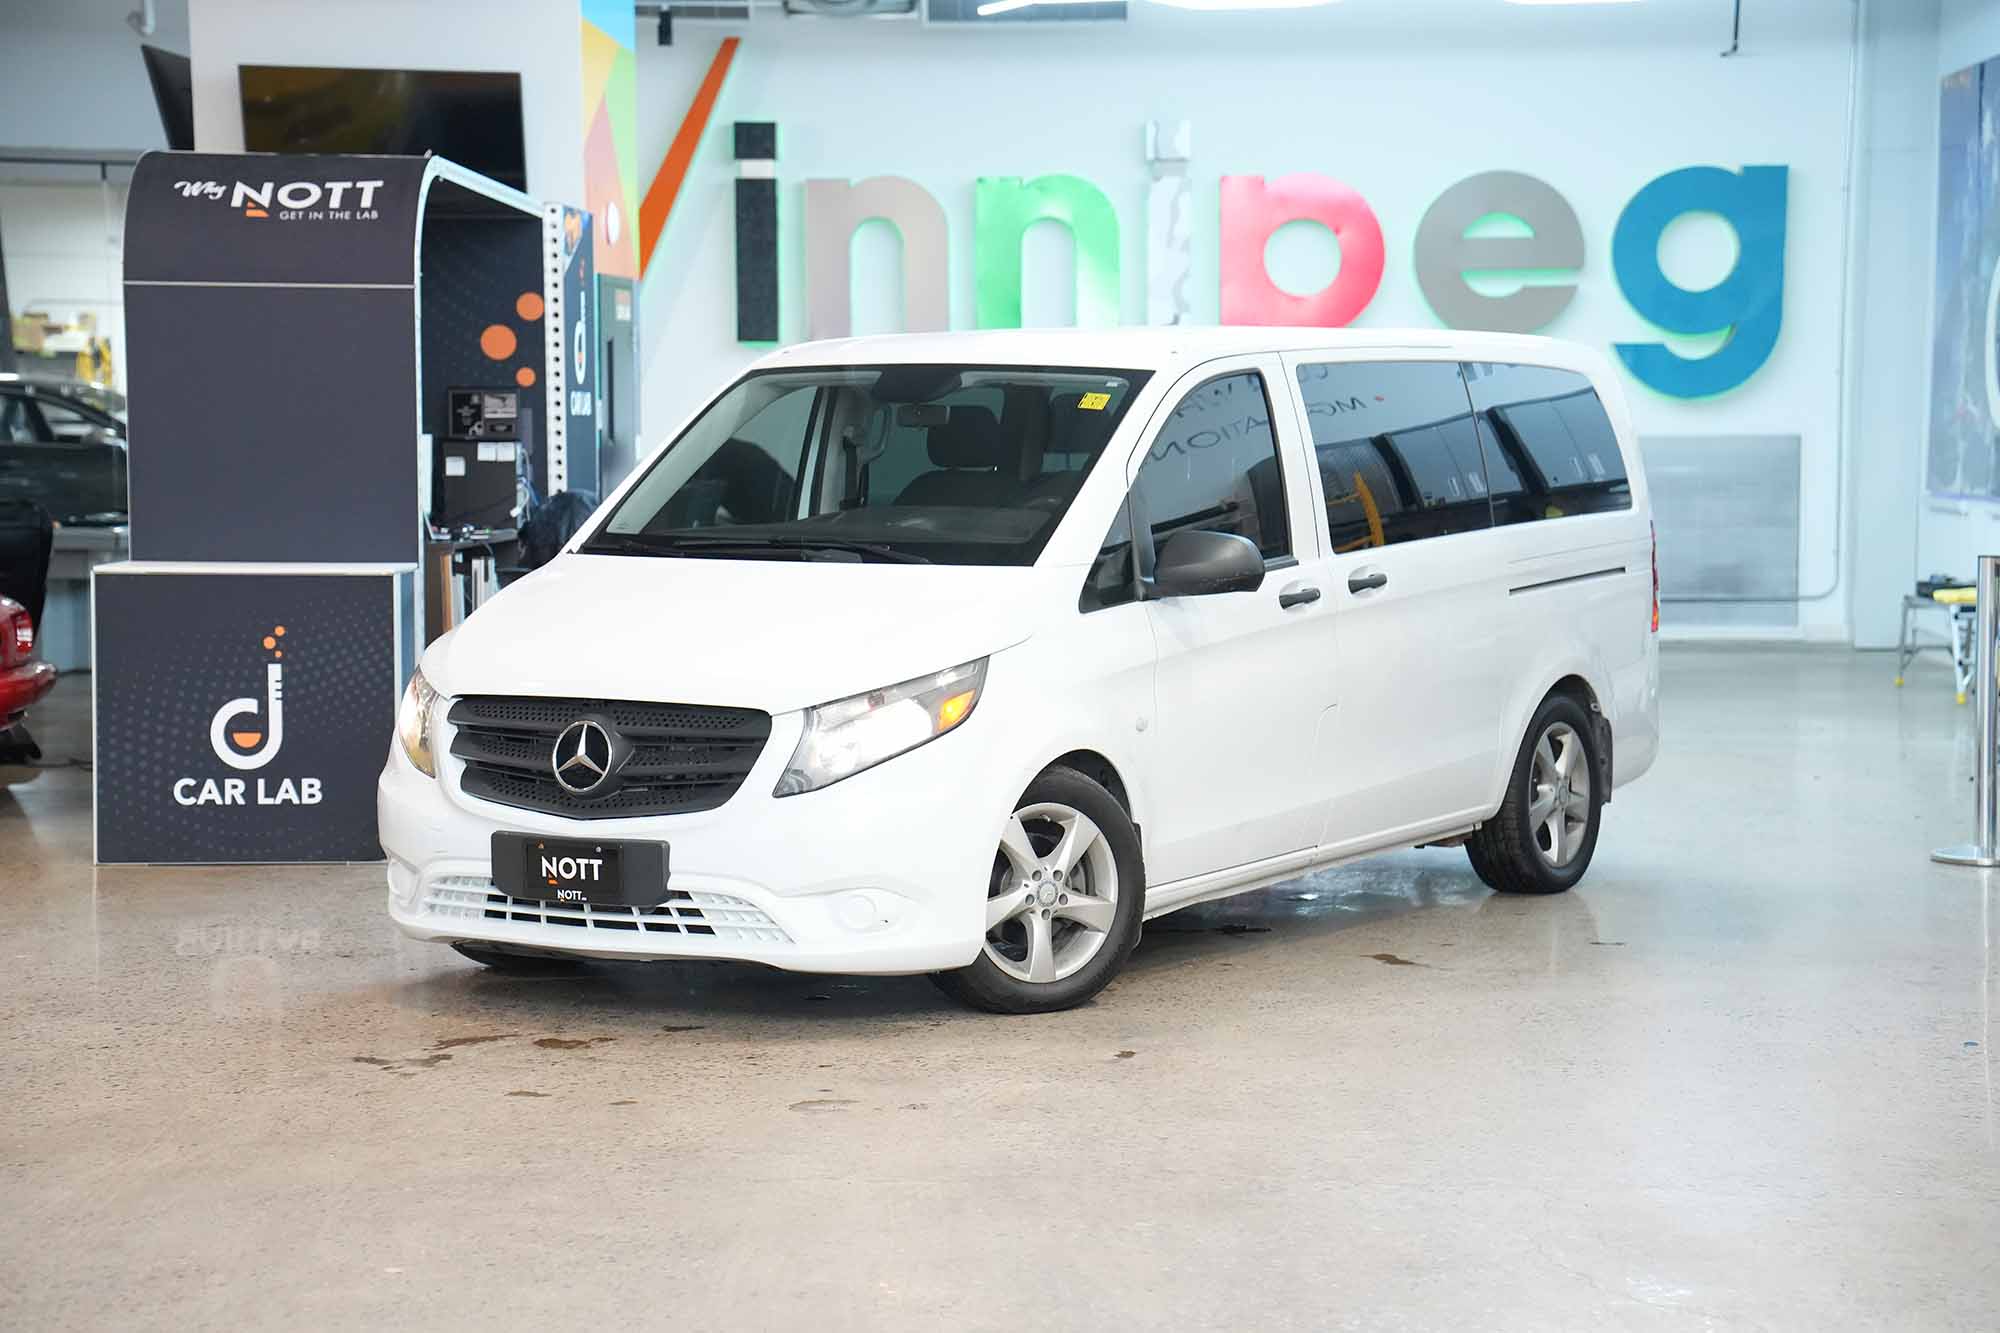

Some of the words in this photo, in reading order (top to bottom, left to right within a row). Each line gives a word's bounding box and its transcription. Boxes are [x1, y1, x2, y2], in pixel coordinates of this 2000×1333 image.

[231, 180, 384, 209] NOTT
[279, 210, 303, 220] GET
[308, 210, 323, 220] IN
[329, 210, 350, 220] THE
[356, 210, 378, 220] LAB
[640, 38, 1788, 399] innipeg
[173, 778, 246, 806] CAR
[257, 778, 322, 805] LAB
[541, 855, 603, 881] NOTT
